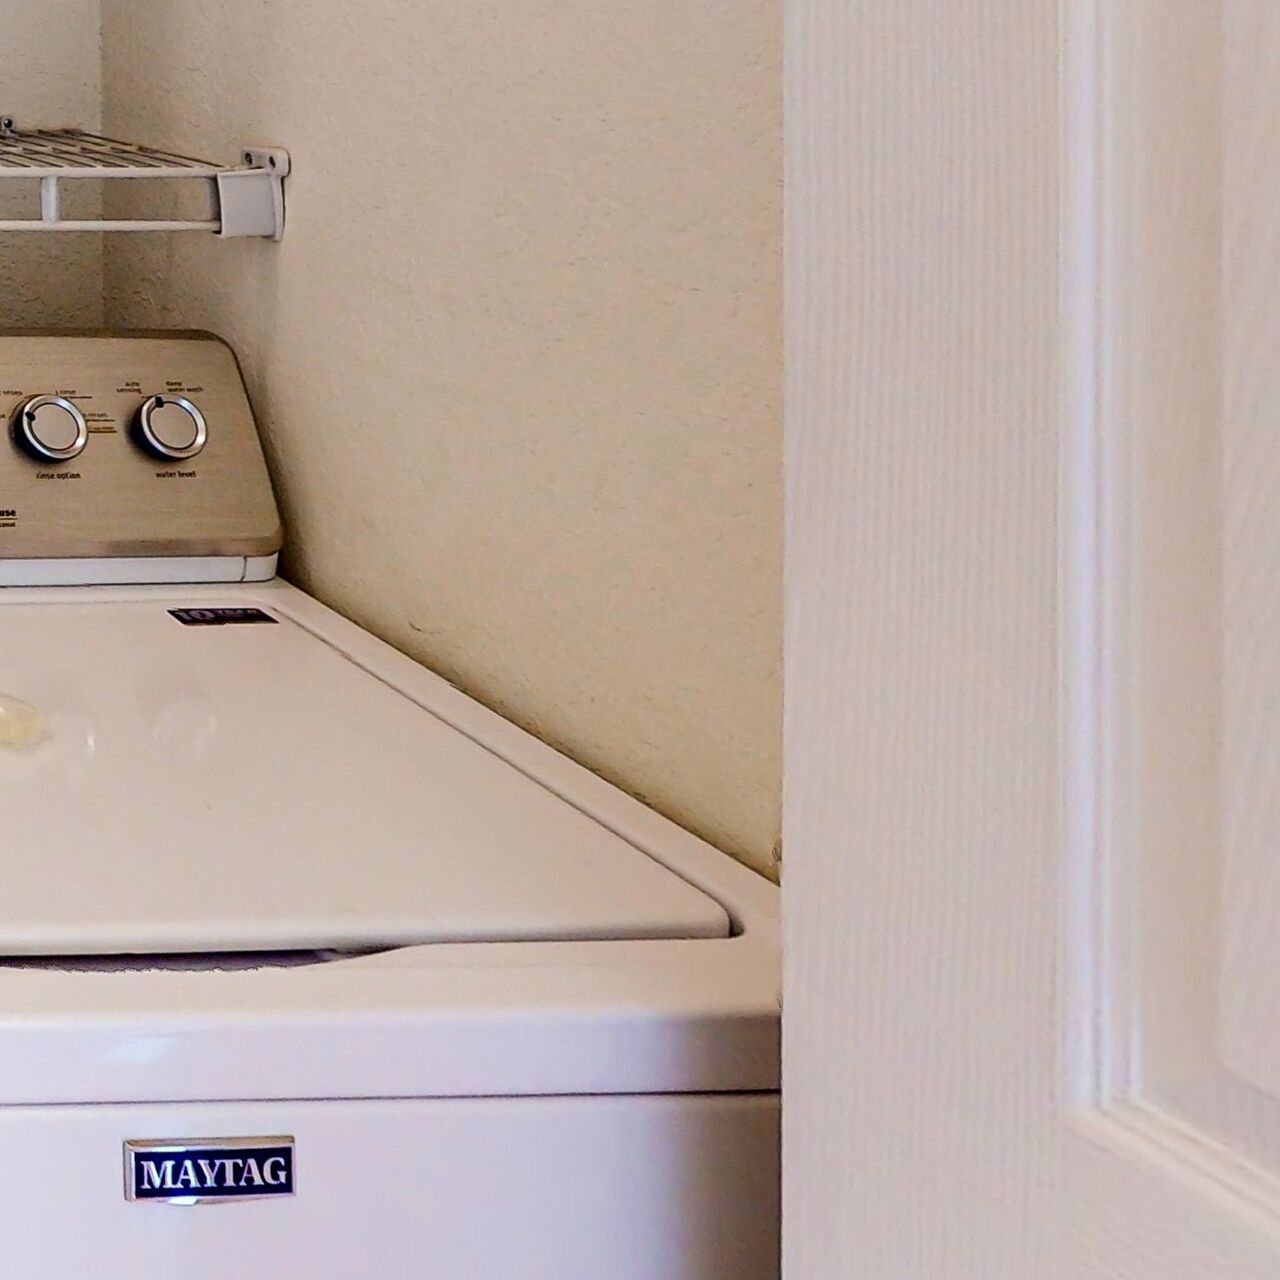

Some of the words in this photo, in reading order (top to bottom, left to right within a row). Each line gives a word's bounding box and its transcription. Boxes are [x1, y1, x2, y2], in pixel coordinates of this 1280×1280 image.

[36, 472, 55, 480] rinse
[56, 472, 81, 480] option
[178, 470, 197, 478] level
[140, 1156, 288, 1190] MAYTAG
